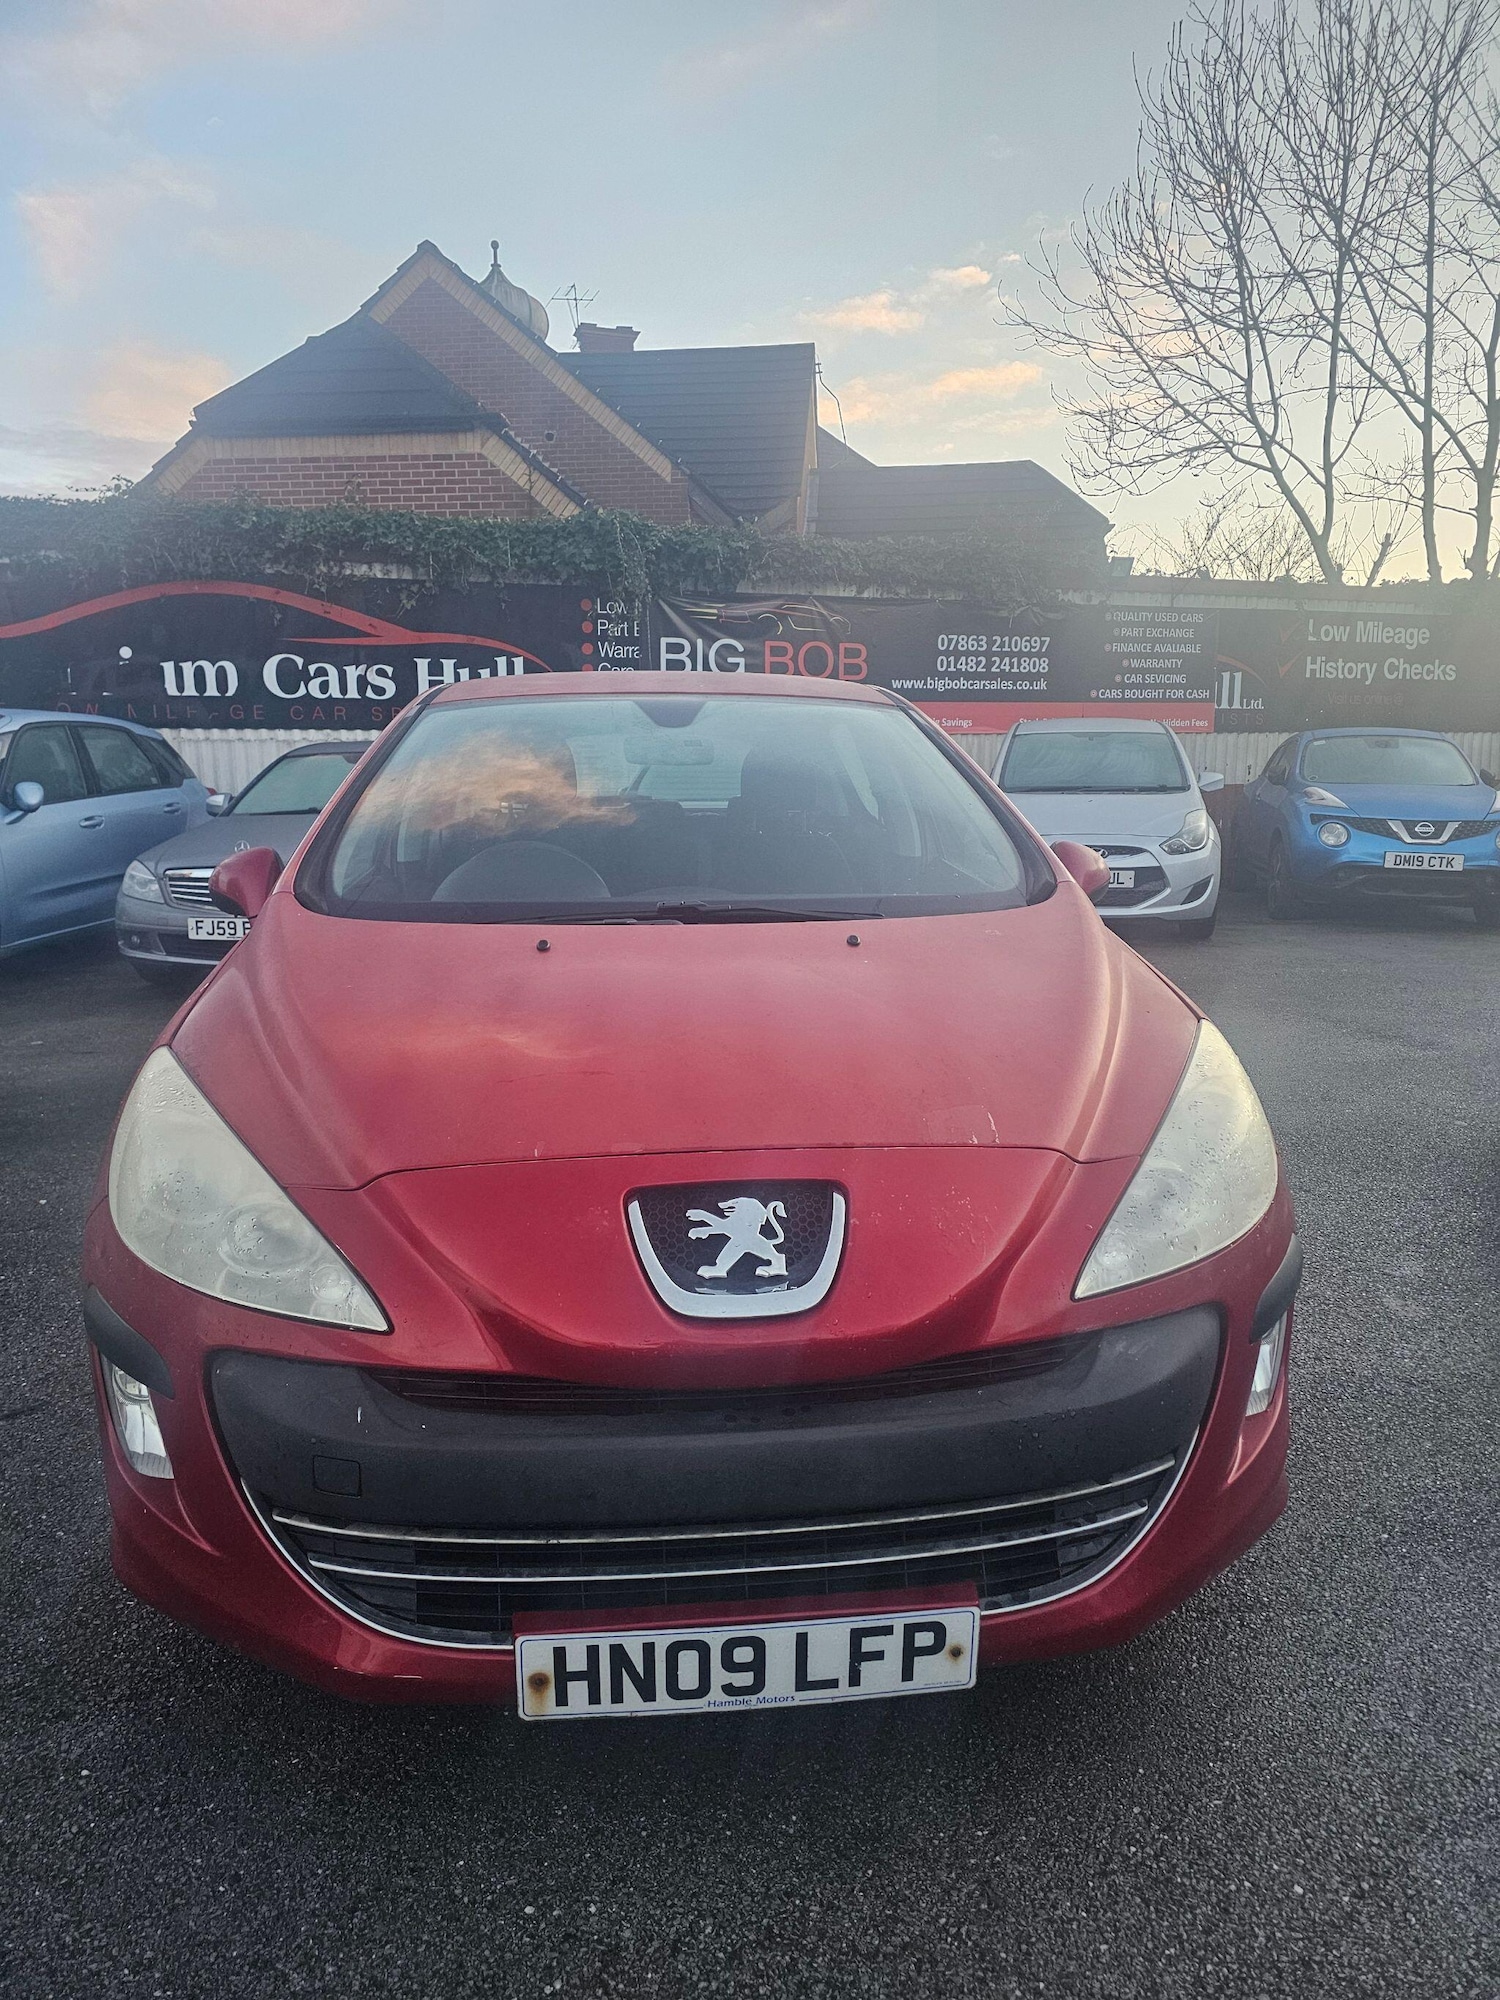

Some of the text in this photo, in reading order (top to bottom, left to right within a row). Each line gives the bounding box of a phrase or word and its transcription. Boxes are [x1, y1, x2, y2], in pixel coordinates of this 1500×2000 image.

[1113, 612, 1204, 623] QUALITY USED CARS
[597, 619, 629, 637] Part
[1120, 628, 1195, 638] PART EXCHANGE
[1307, 618, 1430, 650] Low Mileage
[937, 634, 1050, 652] 07863 210697
[1112, 643, 1202, 654] FINANCE AVALIABLE
[659, 637, 868, 681] BIG BOB
[936, 655, 1049, 673] 01482 241808
[1130, 658, 1183, 669] WARRANTY
[262, 653, 397, 700] Cars
[1305, 655, 1457, 685] History Checks
[891, 677, 1048, 692] www.bigbobcarsales.co.uk
[1124, 674, 1187, 684] CAR SEVICING
[1098, 689, 1210, 699] CARS BOUGHT FOR CASH
[1242, 698, 1265, 710] Ltd.
[290, 706, 347, 721] CAR
[941, 718, 973, 728] Savings
[1163, 718, 1190, 727] Hidden
[1191, 719, 1209, 727] Fees
[1393, 854, 1456, 869] DM19 CTK
[195, 920, 237, 936] FJ59
[552, 1620, 947, 1707] HN09 LFP
[707, 1695, 795, 1708] Hamble Motors
